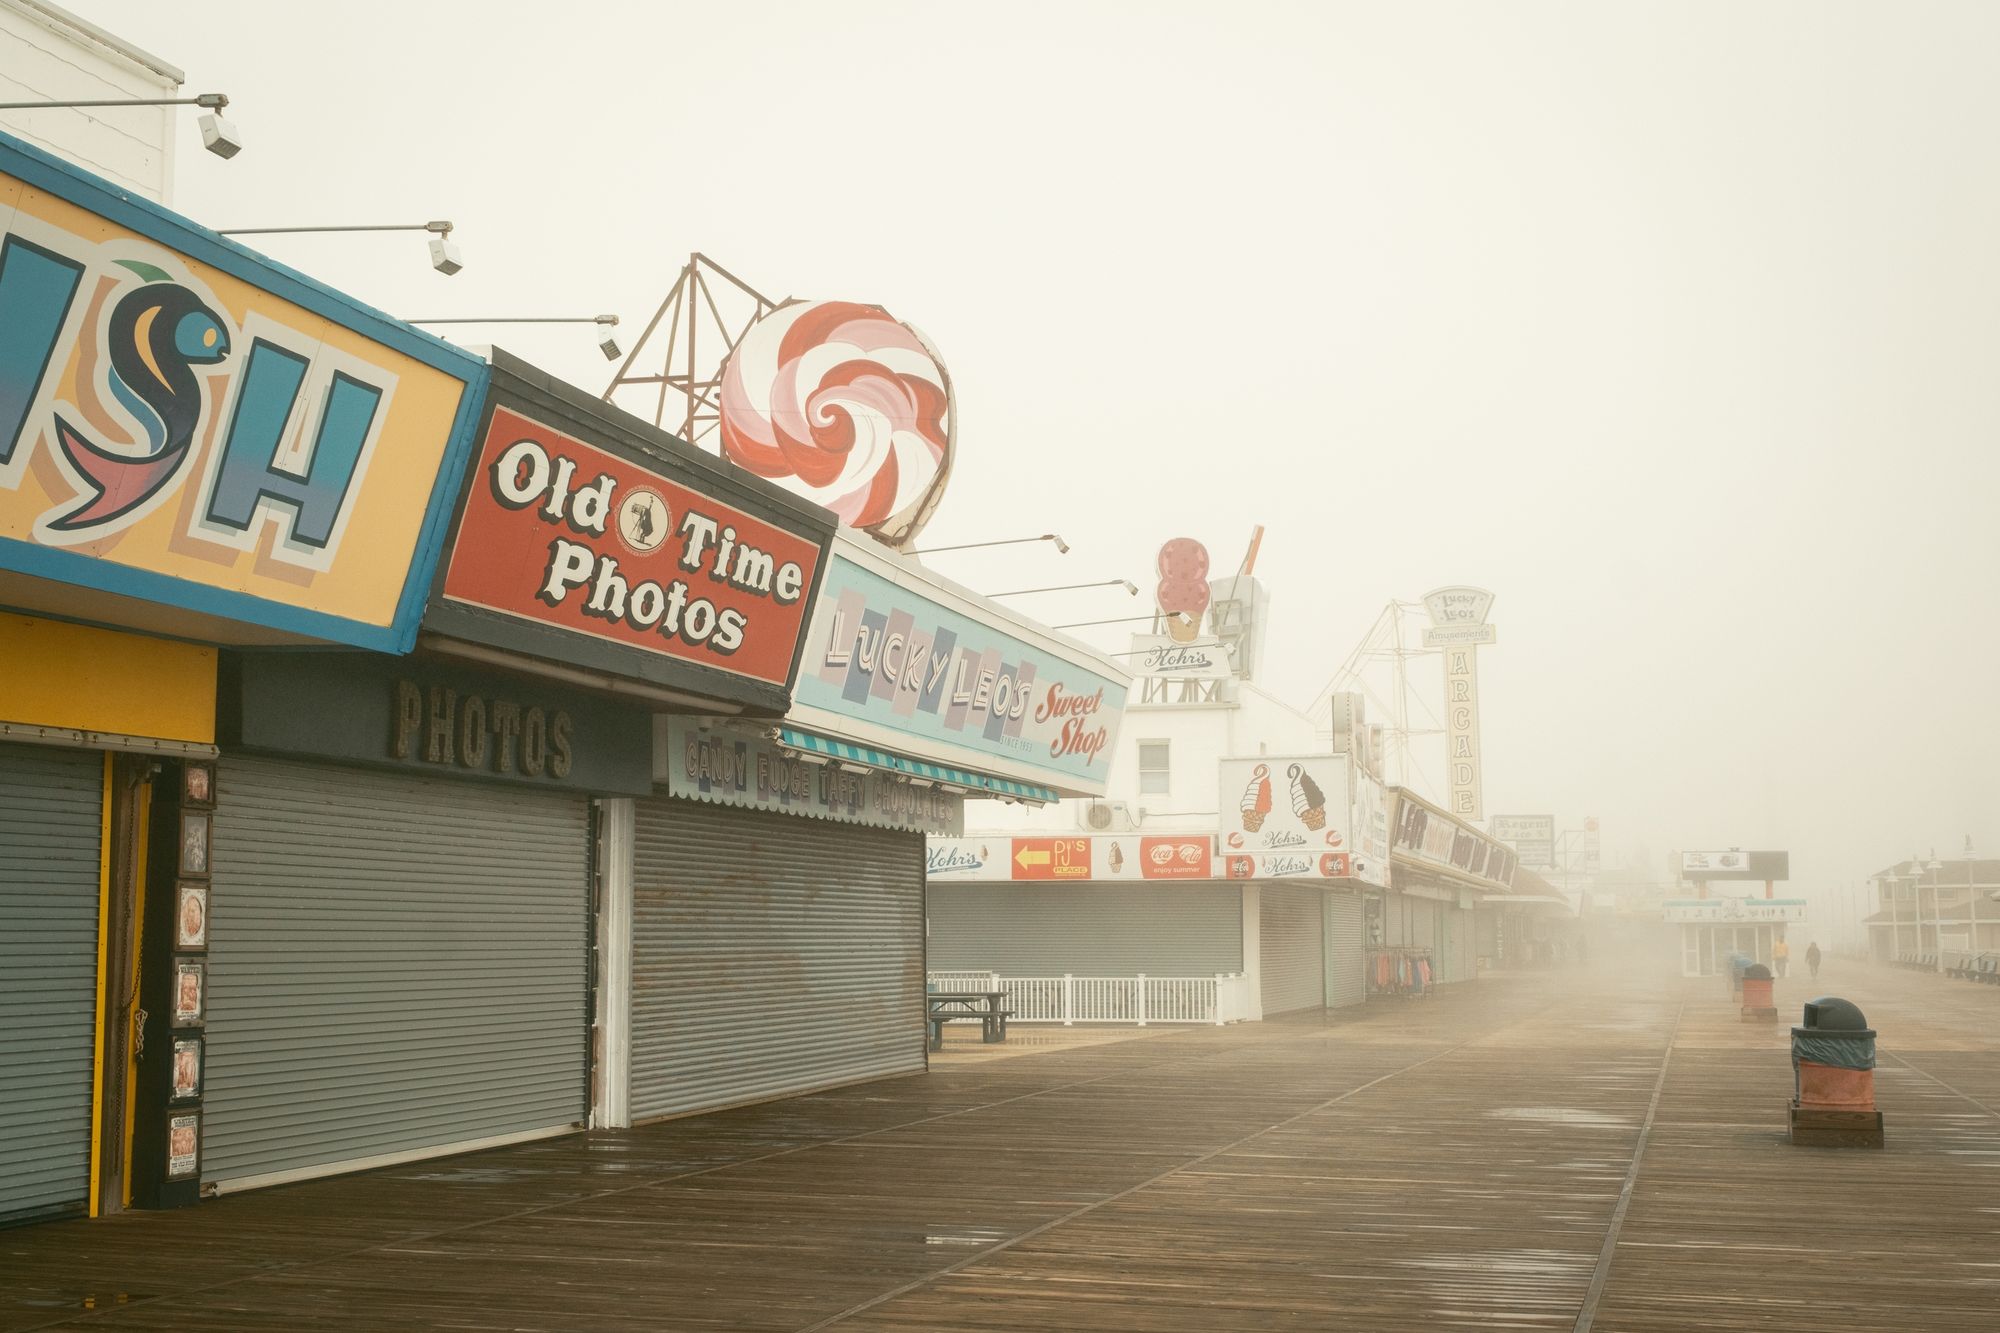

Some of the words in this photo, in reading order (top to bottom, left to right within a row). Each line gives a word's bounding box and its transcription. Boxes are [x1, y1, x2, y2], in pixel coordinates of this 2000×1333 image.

[494, 441, 617, 533] Old
[681, 511, 803, 600] Time
[543, 539, 747, 651] Photos
[1144, 645, 1206, 667] Kohr's
[952, 657, 1032, 719] LEO'S
[1035, 681, 1103, 724] Sweet
[396, 680, 574, 779] PHOTOS
[1050, 717, 1108, 767] Shop
[1450, 652, 1475, 814] ARCADE
[685, 742, 746, 786] CANDY
[758, 757, 810, 797] FUDGE
[819, 769, 865, 808] TAFFY
[1263, 831, 1302, 846] Kohr's
[1265, 856, 1305, 873] Kohr's
